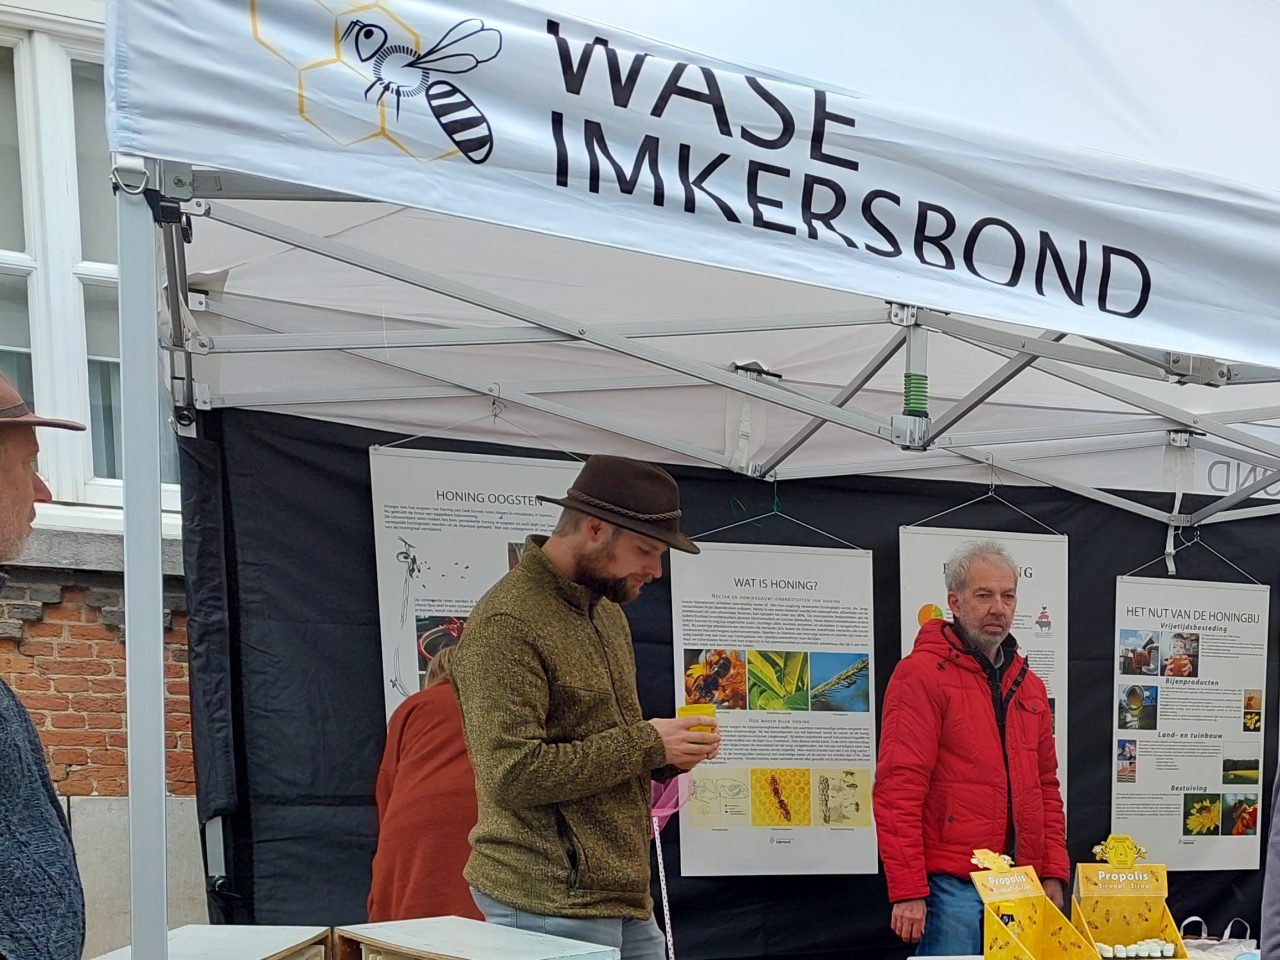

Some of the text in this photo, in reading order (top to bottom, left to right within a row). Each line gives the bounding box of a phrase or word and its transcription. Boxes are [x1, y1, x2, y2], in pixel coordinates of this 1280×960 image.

[546, 19, 860, 171] WASE
[550, 111, 1153, 319] IMKERSBOND
[436, 489, 544, 507] HONING OOGSTEN
[733, 577, 819, 591] WAT IS HONING?
[1126, 606, 1261, 624] HET NUT VAN DE HONINGBIJ
[1160, 622, 1228, 633] Vrijetijdsbesteding
[1165, 677, 1220, 687] Bijenproducten
[1157, 731, 1179, 739] Land-
[1170, 784, 1208, 792] Bestuiving
[988, 874, 1027, 887] Propolis
[1098, 870, 1149, 883] Propolis
